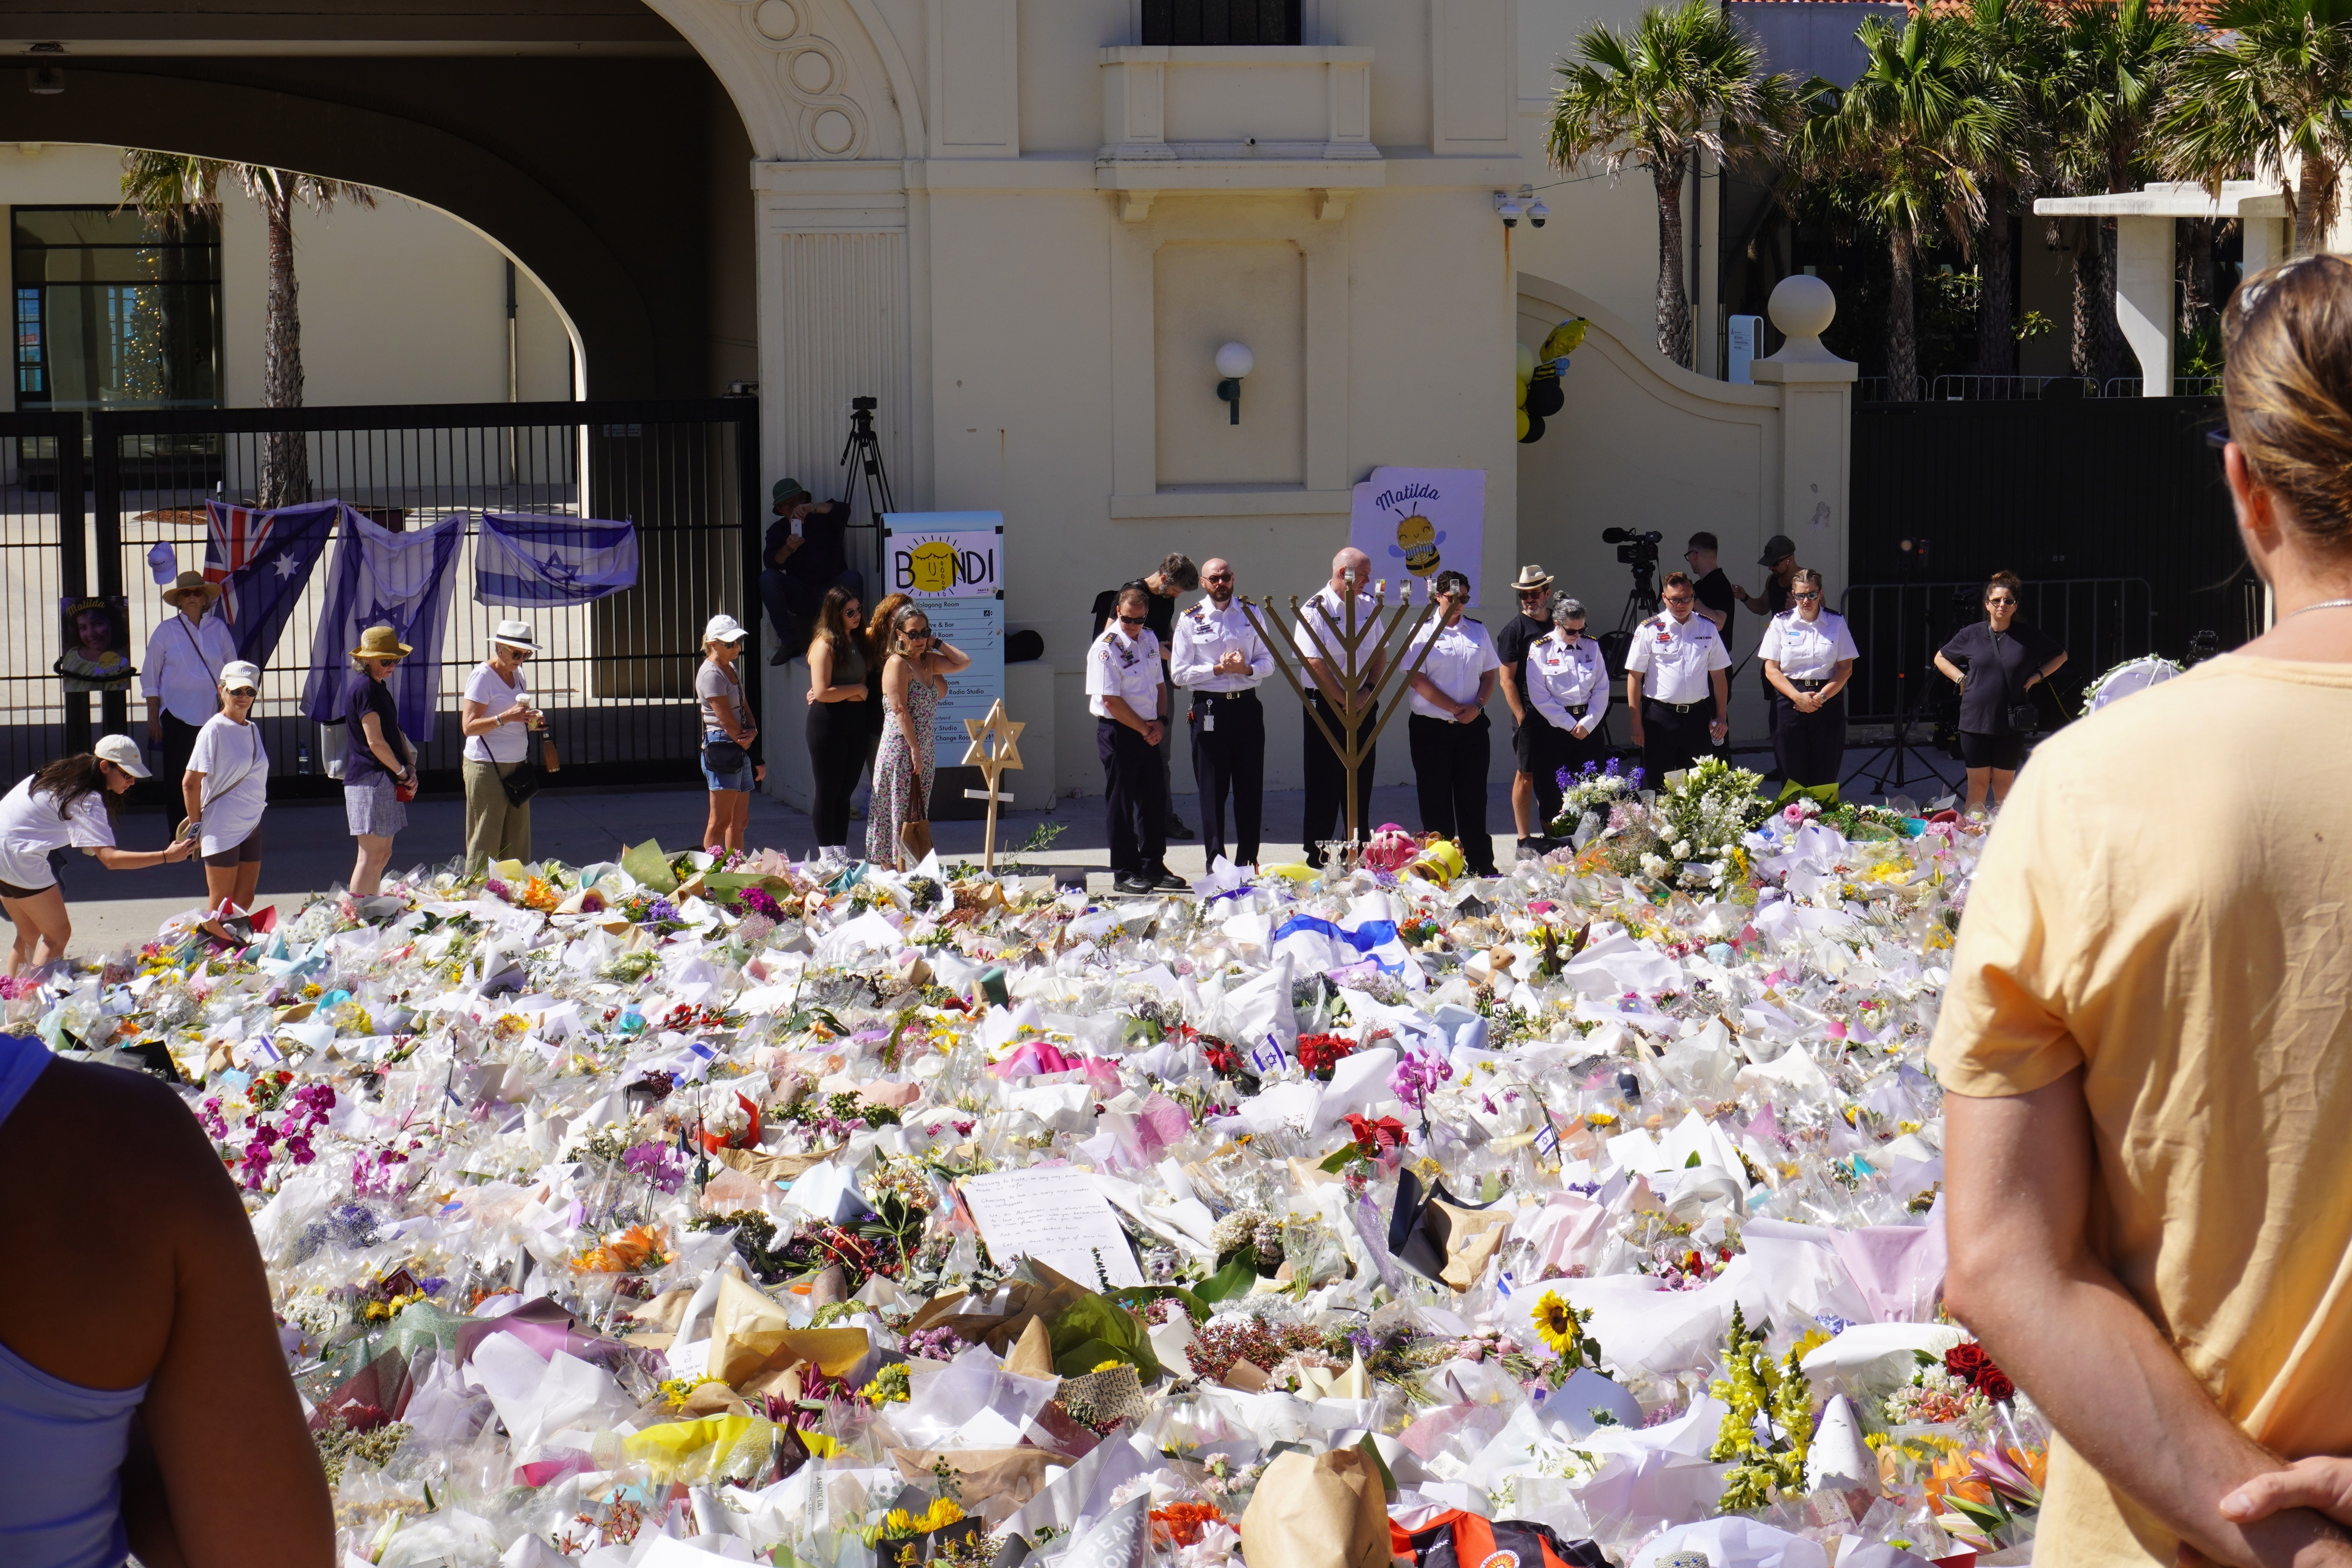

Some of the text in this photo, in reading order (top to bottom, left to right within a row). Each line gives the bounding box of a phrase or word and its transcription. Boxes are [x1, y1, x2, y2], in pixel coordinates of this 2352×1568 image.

[1376, 483, 1440, 511] Matilda
[66, 599, 105, 616] Matilda
[1501, 1550, 1519, 1563] ILINDEN
